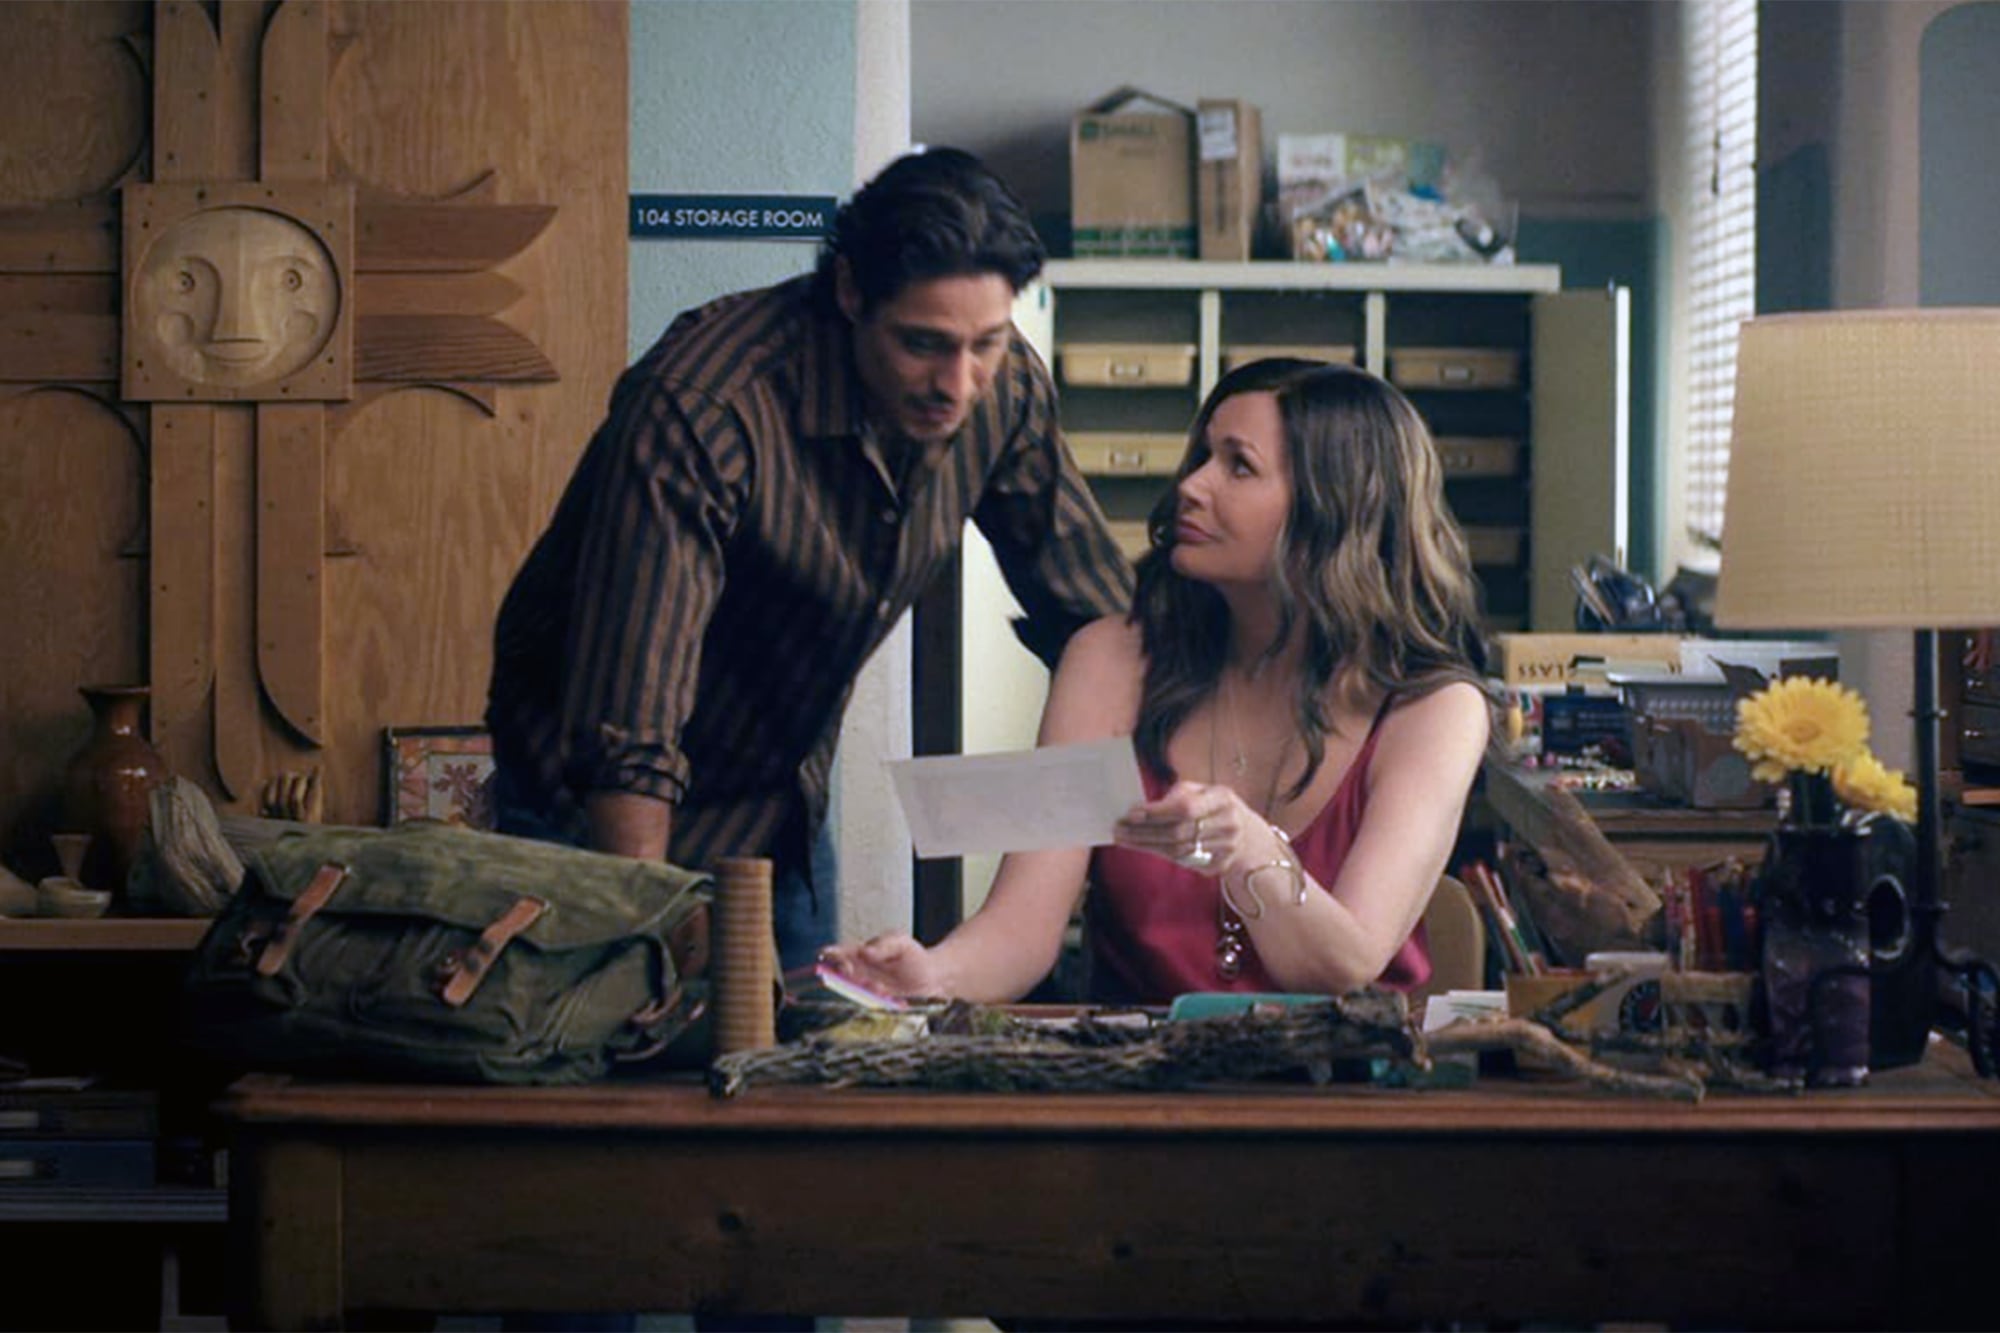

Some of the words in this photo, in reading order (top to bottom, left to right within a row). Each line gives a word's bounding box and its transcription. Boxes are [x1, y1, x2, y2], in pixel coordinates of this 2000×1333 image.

[637, 208, 670, 226] 104
[674, 207, 759, 227] STORAGE
[763, 210, 824, 228] ROOM
